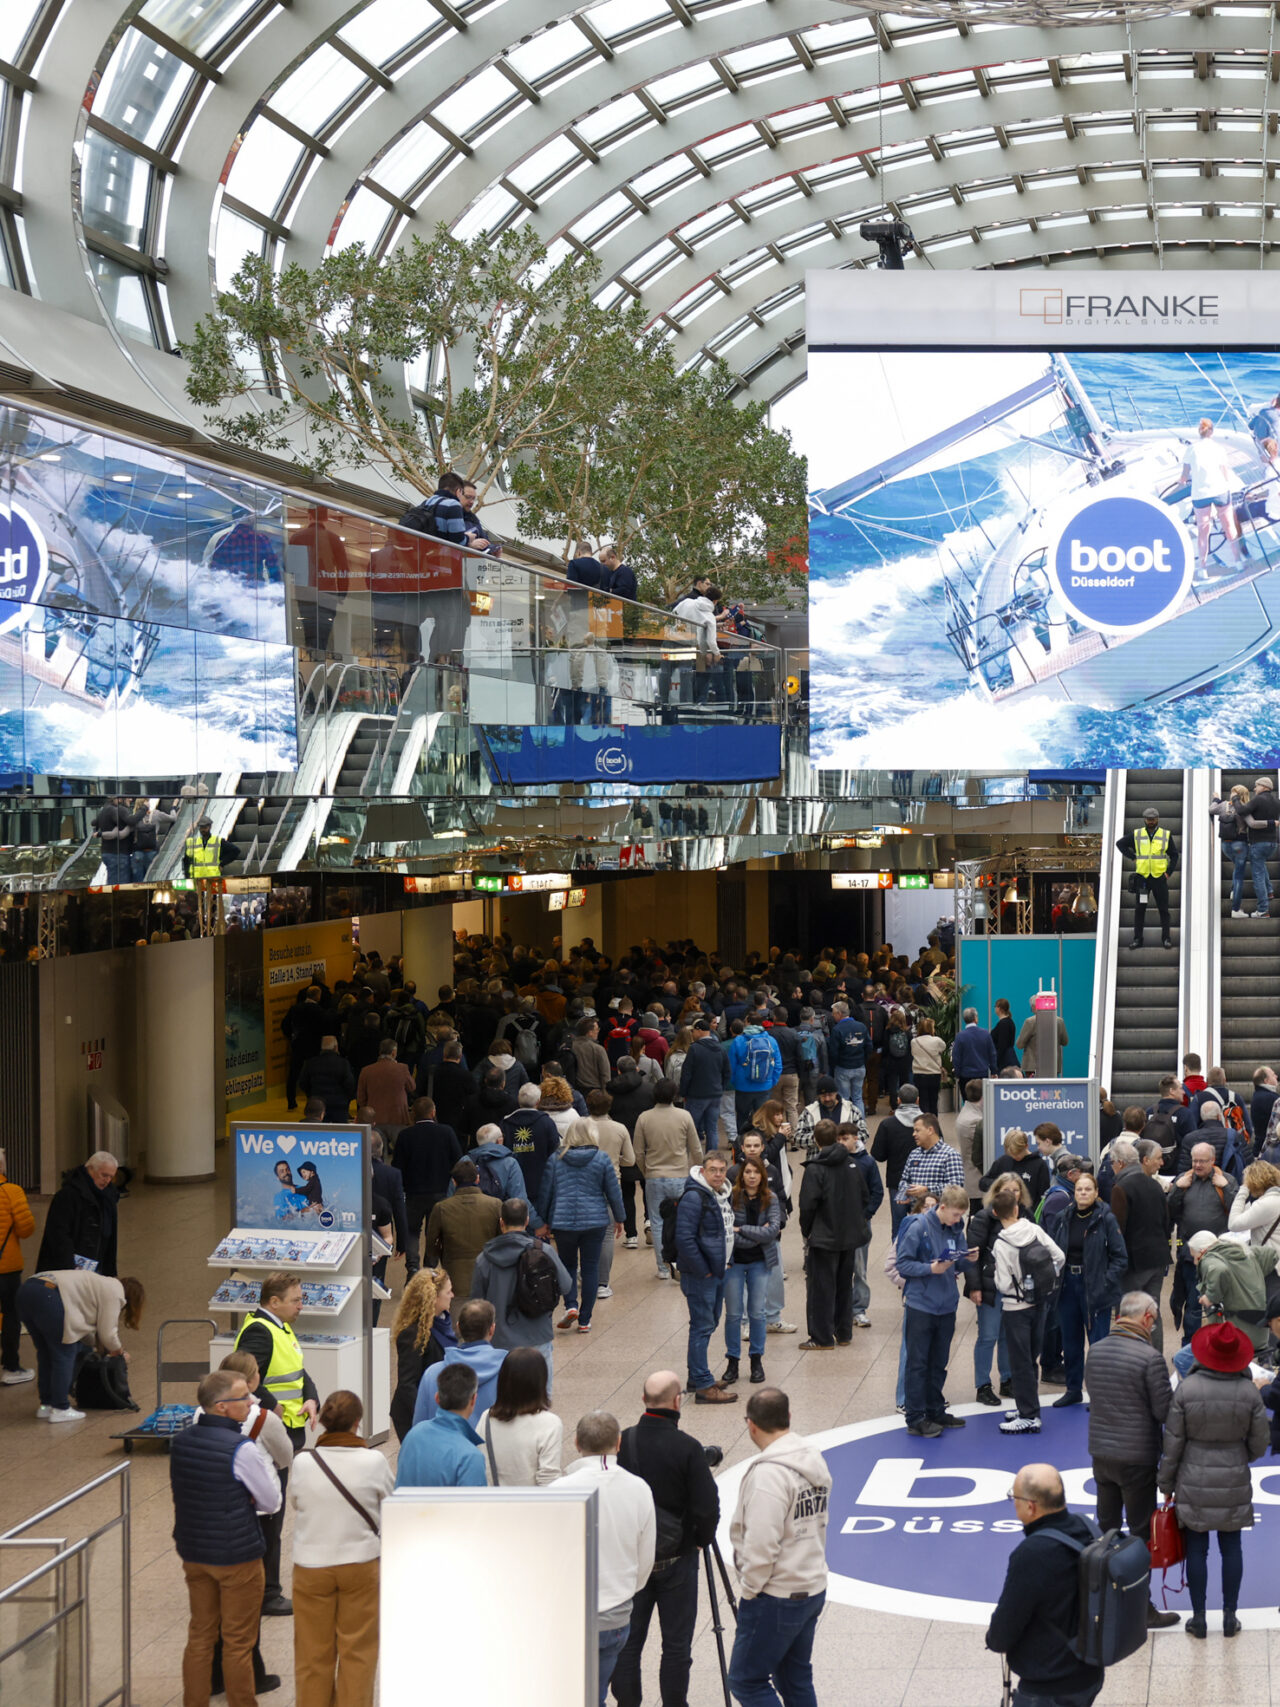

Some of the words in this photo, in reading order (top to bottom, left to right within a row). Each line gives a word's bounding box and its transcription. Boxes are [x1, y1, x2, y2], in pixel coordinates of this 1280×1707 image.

[1066, 295, 1219, 318] FRANKE
[1070, 539, 1172, 573] boot
[1070, 576, 1136, 588] Düsseldorf
[848, 879, 869, 888] 14-17
[269, 943, 294, 961] Besuche
[269, 968, 286, 985] Halle
[296, 963, 313, 979] Stand
[1025, 1099, 1084, 1112] generation
[240, 1134, 274, 1154] We
[300, 1138, 359, 1157] water
